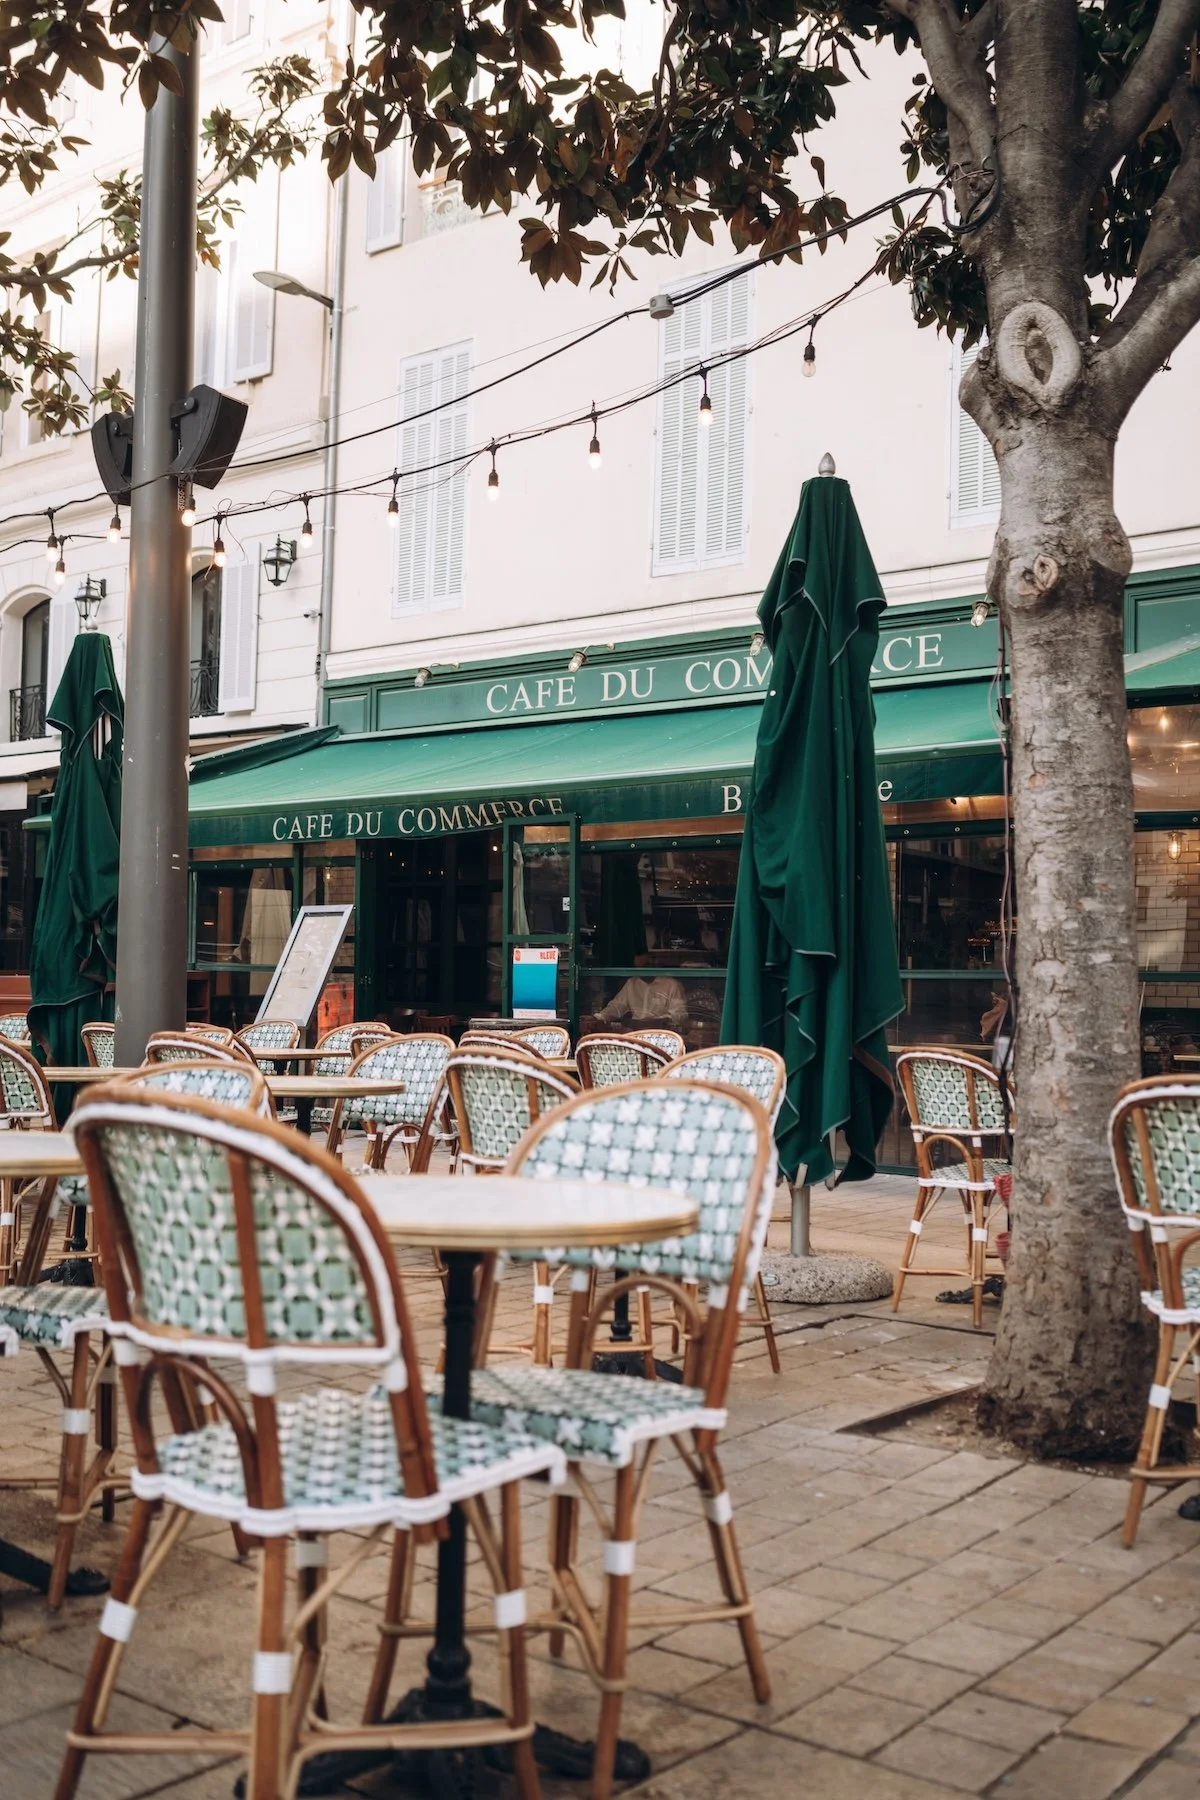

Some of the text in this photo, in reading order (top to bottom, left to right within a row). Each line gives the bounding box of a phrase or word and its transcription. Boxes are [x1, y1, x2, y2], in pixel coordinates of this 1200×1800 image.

[486, 633, 944, 714] CAFE DU COMCE
[272, 813, 334, 841] CAFE
[346, 811, 384, 836] DU
